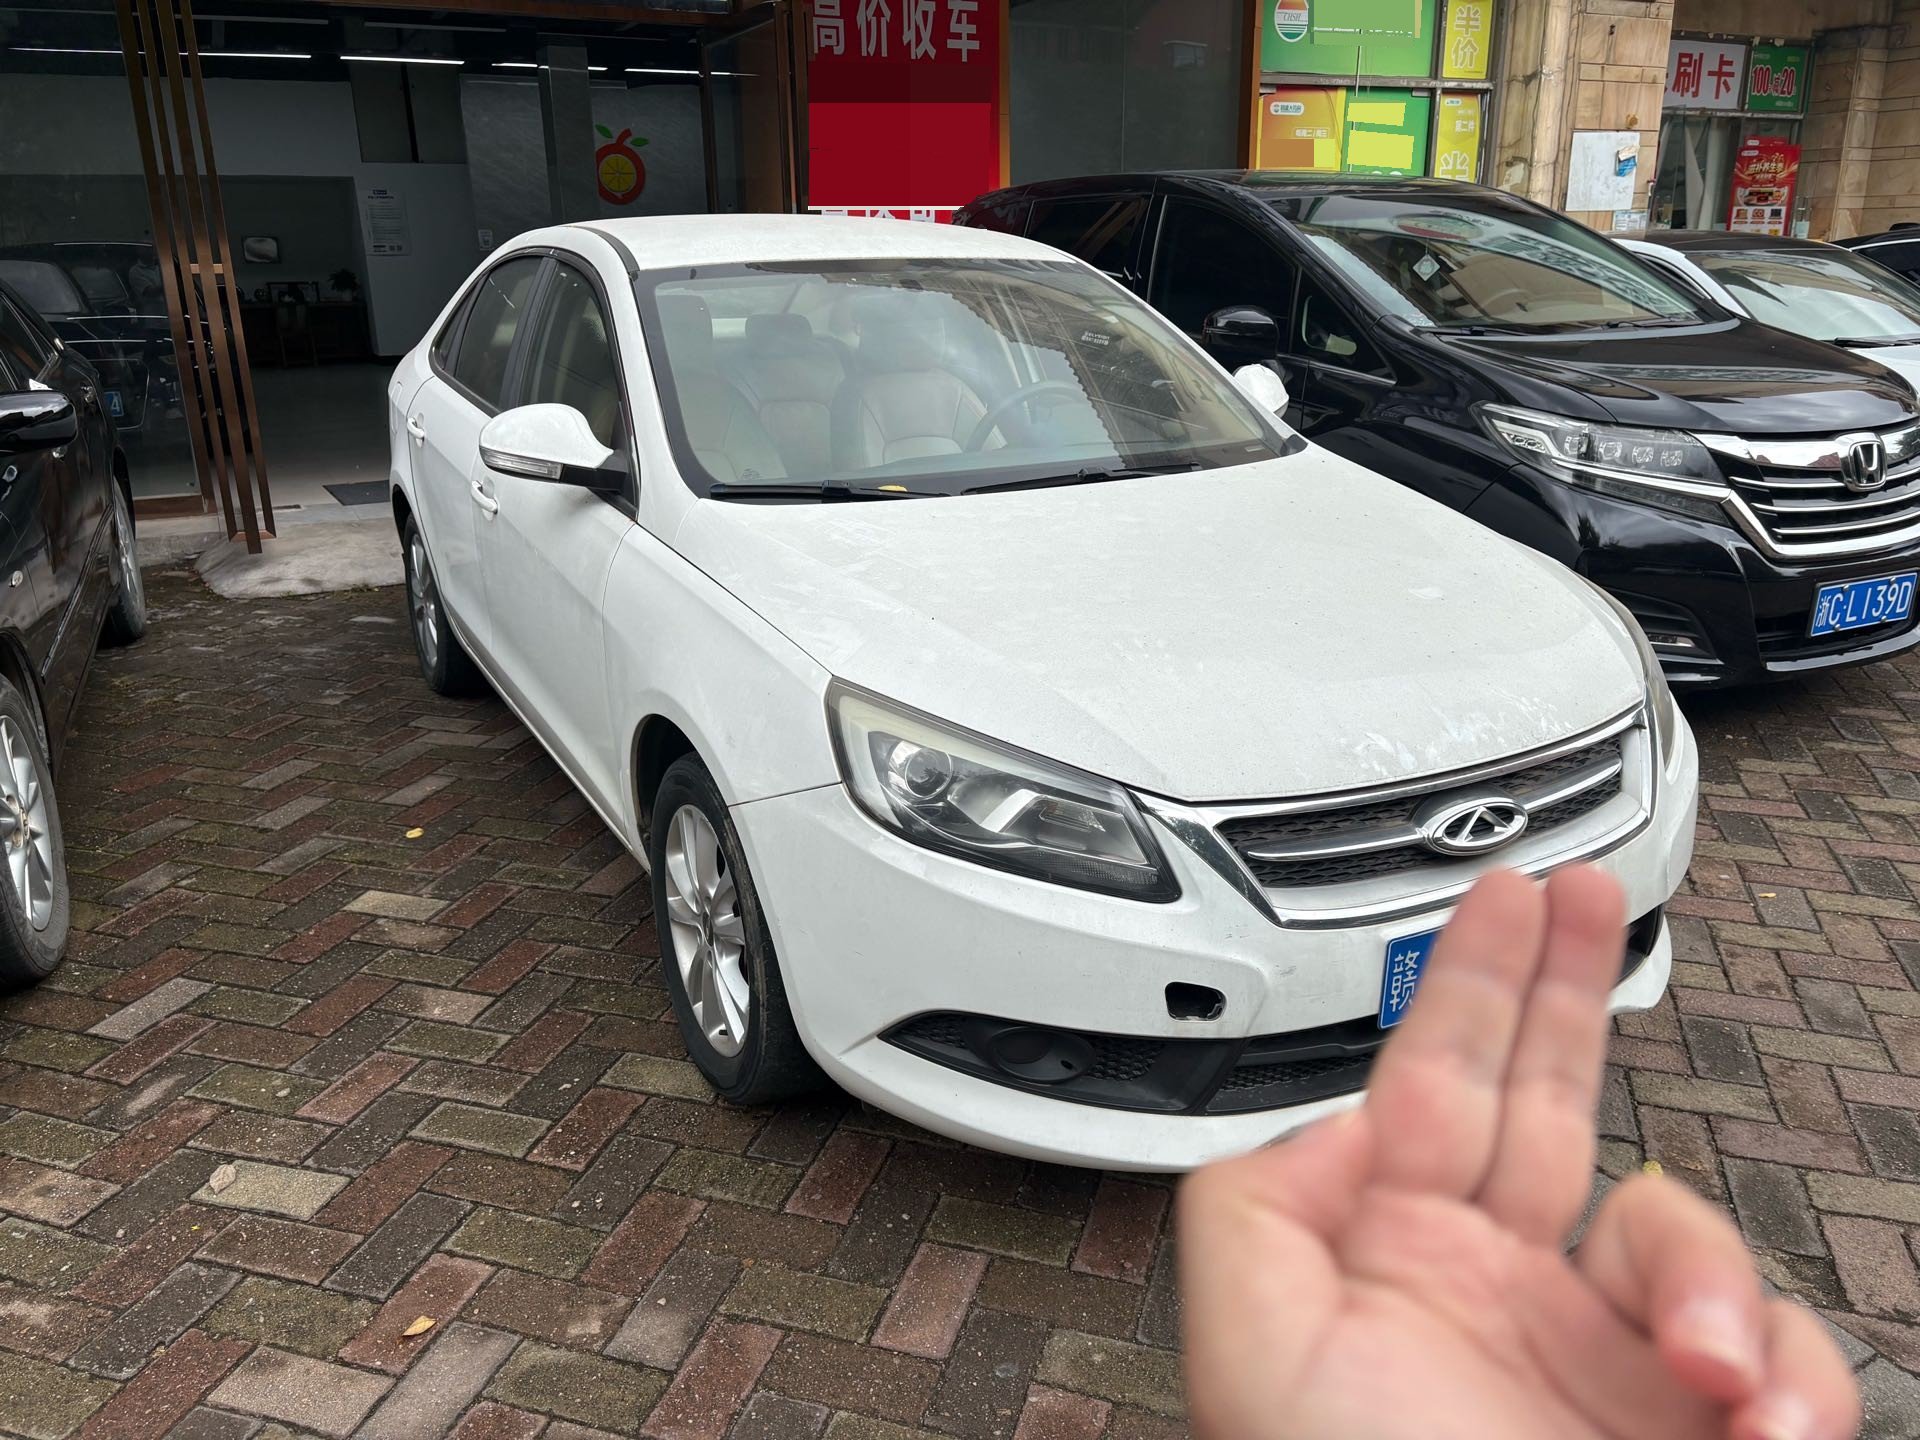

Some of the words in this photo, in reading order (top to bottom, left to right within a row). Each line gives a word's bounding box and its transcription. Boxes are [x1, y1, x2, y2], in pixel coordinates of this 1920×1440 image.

[812, 0, 981, 62] 高价收车
[1452, 5, 1481, 69] 半价
[1664, 52, 1735, 100] 刷卡
